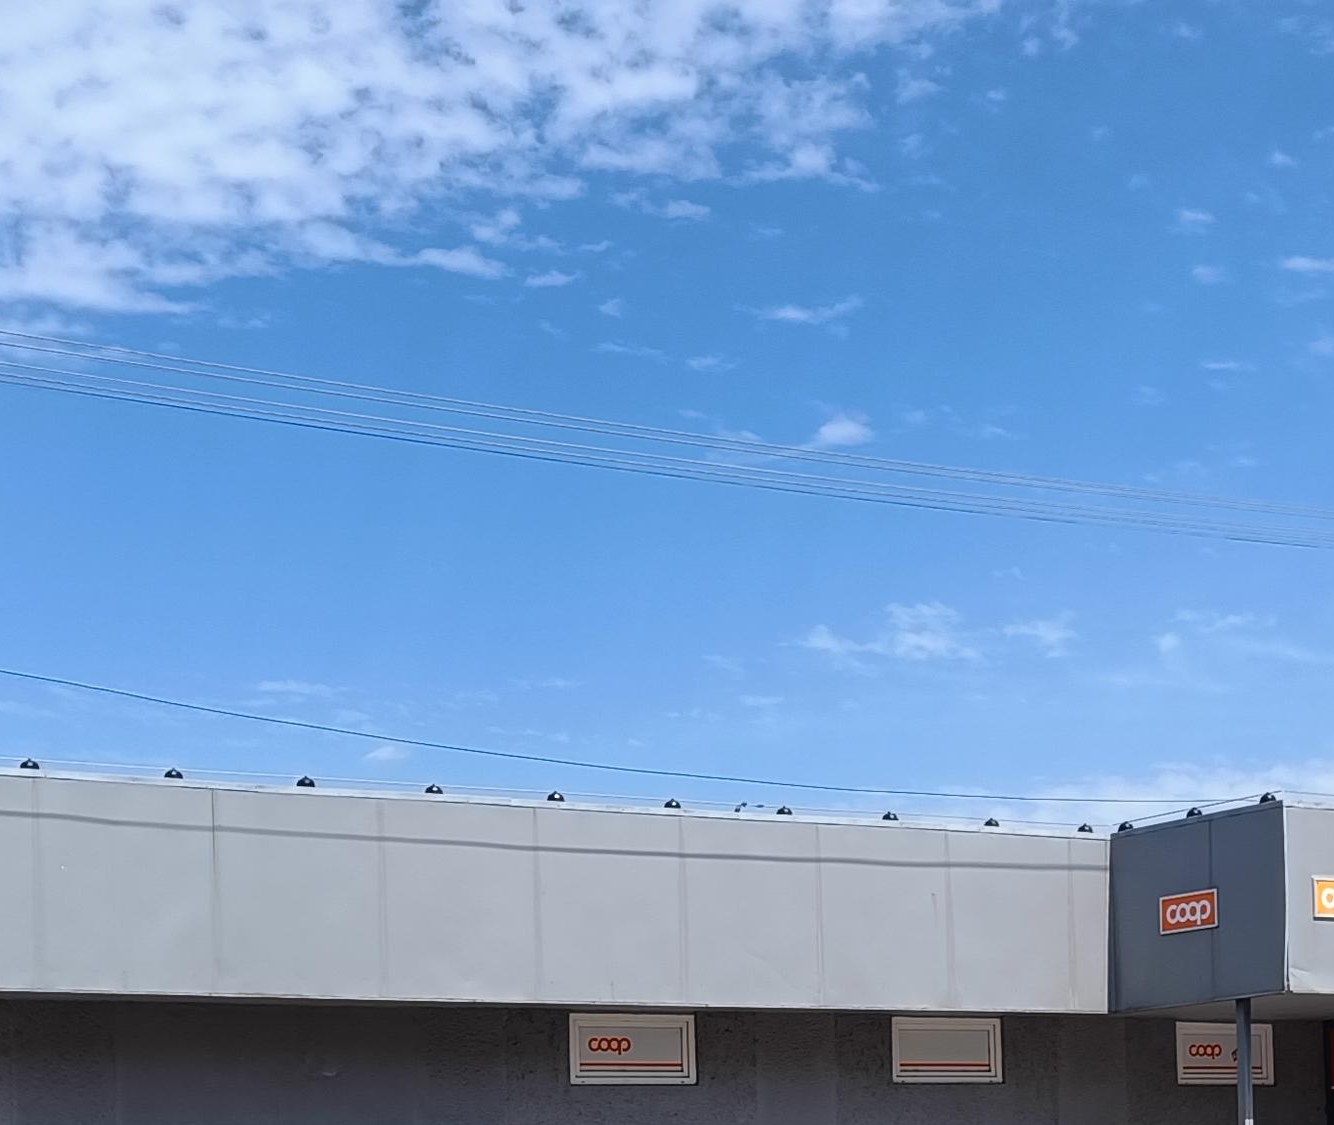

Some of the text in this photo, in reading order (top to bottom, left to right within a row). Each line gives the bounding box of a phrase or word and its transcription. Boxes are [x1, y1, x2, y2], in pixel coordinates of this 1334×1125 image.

[1166, 899, 1211, 925] coop
[587, 1037, 632, 1056] coop
[1188, 1044, 1222, 1060] coop
